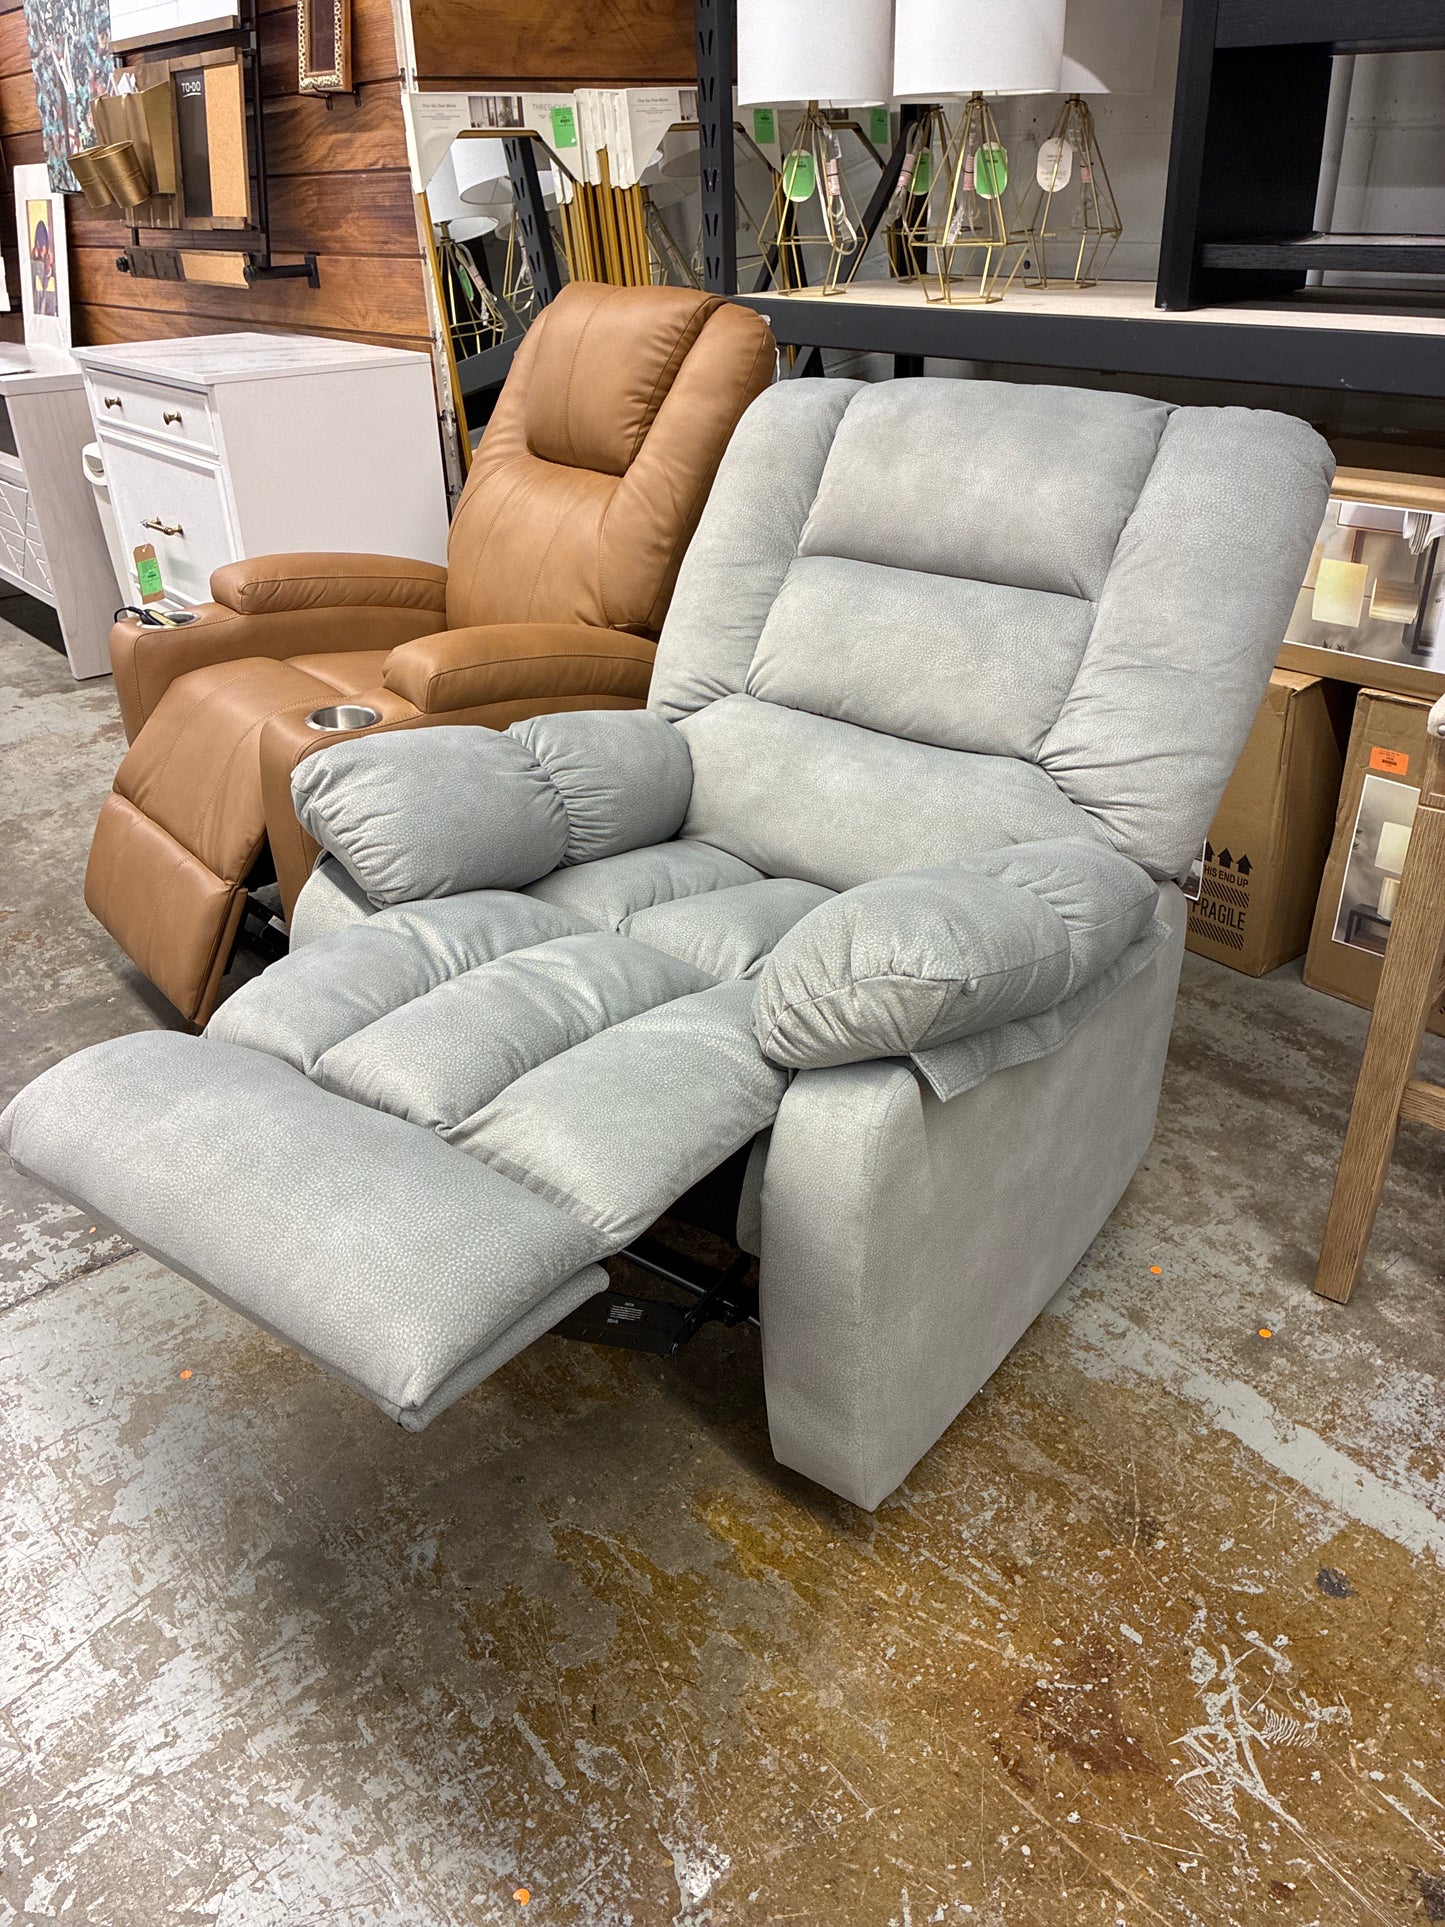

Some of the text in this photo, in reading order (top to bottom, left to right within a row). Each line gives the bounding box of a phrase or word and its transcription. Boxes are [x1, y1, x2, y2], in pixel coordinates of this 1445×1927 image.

[181, 81, 201, 92] TO-DO
[1218, 870, 1236, 884] END
[1236, 876, 1249, 888] UP
[1191, 897, 1246, 932] FRAGILE
